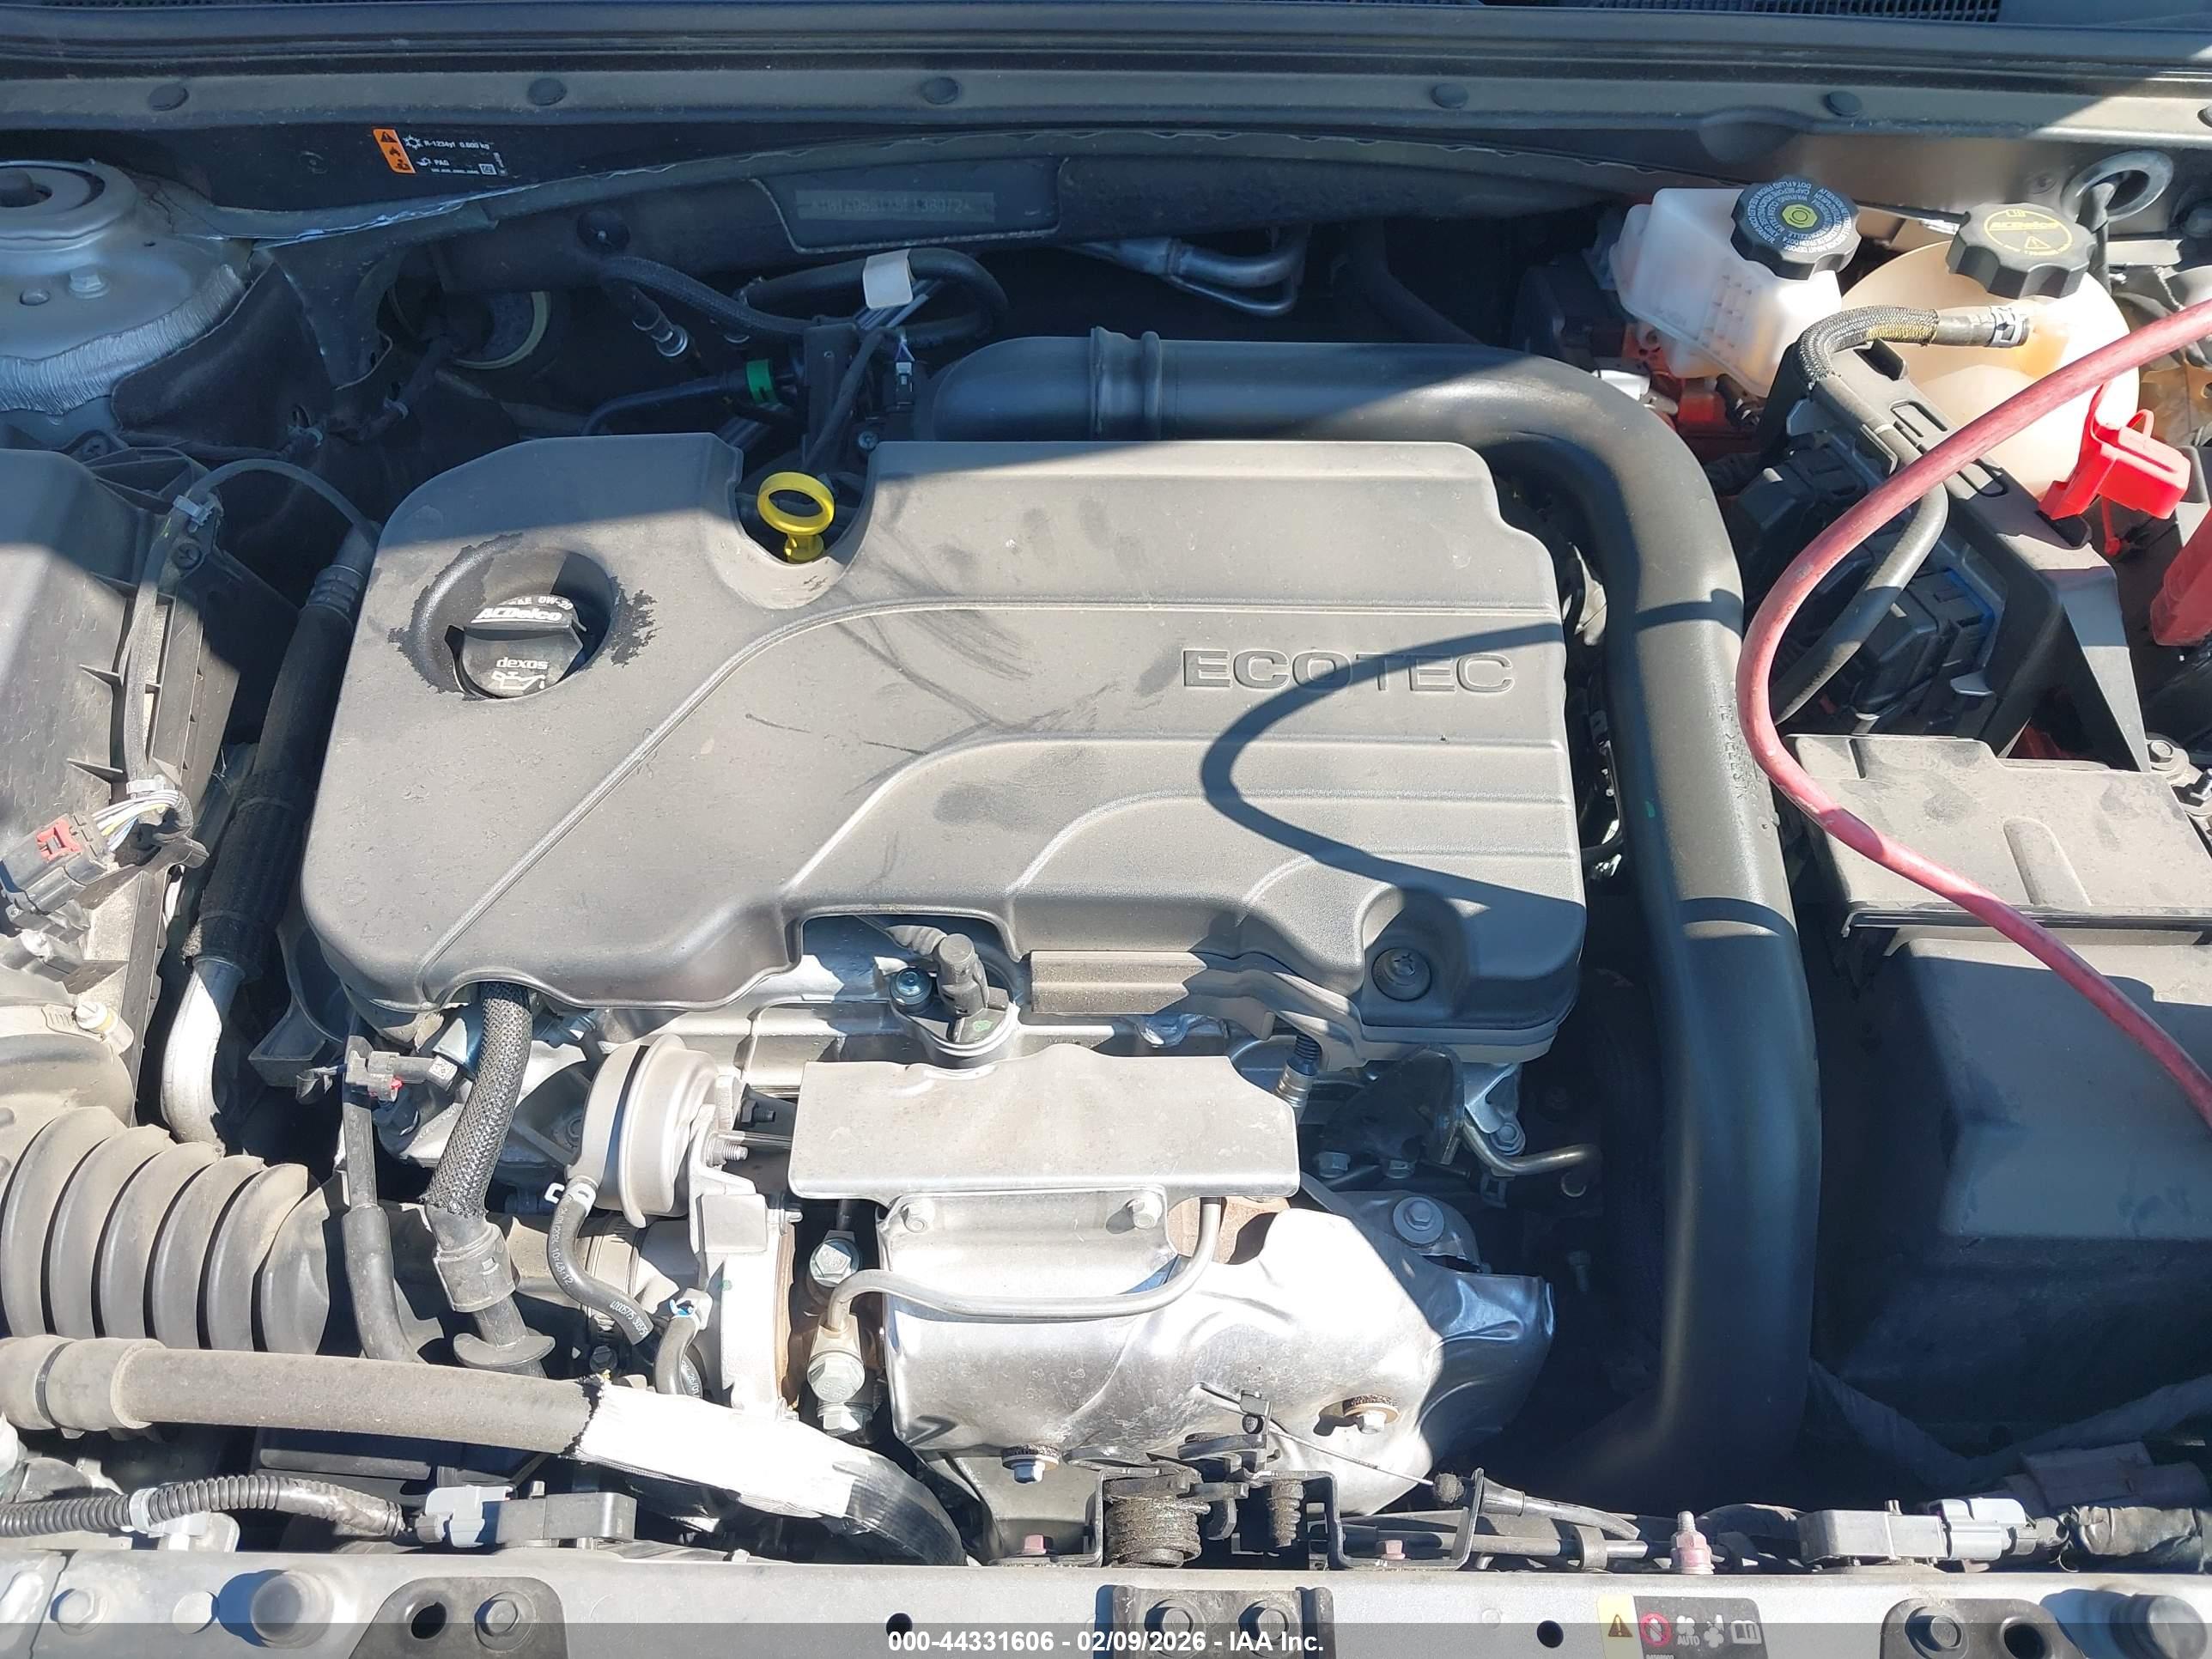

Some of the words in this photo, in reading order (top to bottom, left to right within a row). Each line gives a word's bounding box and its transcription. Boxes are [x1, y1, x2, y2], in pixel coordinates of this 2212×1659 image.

[538, 596, 574, 611] 0W-20
[475, 607, 563, 622] ACDelco
[495, 657, 549, 670] dexos
[1182, 649, 1516, 694] ECOTEC
[1677, 1635, 1700, 1645] AUTO
